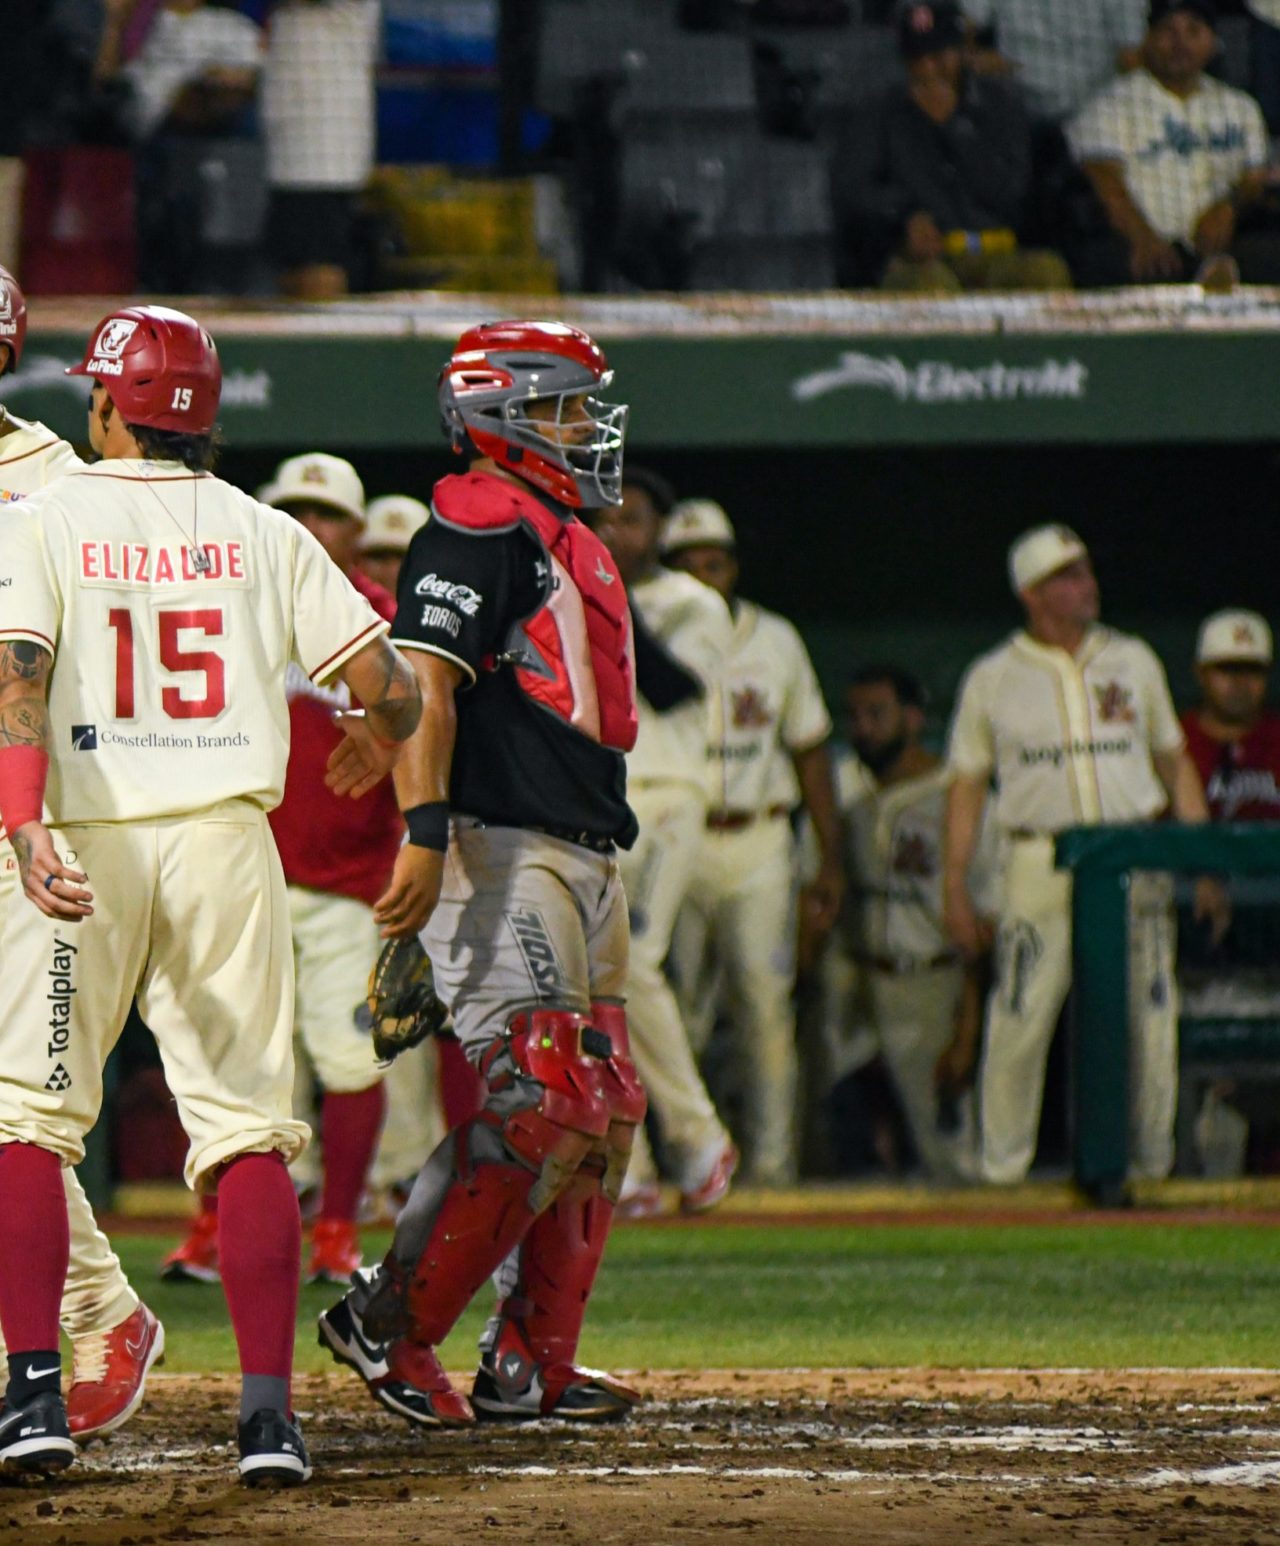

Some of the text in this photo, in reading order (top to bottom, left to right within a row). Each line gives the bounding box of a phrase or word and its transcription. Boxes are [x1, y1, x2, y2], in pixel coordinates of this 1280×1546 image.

[172, 387, 193, 411] 15
[81, 542, 246, 582] ELIZALDE
[421, 604, 462, 639] TOROS
[108, 608, 227, 719] 15
[101, 731, 250, 748] Constellation Brands
[47, 938, 78, 1058] Totalplay
